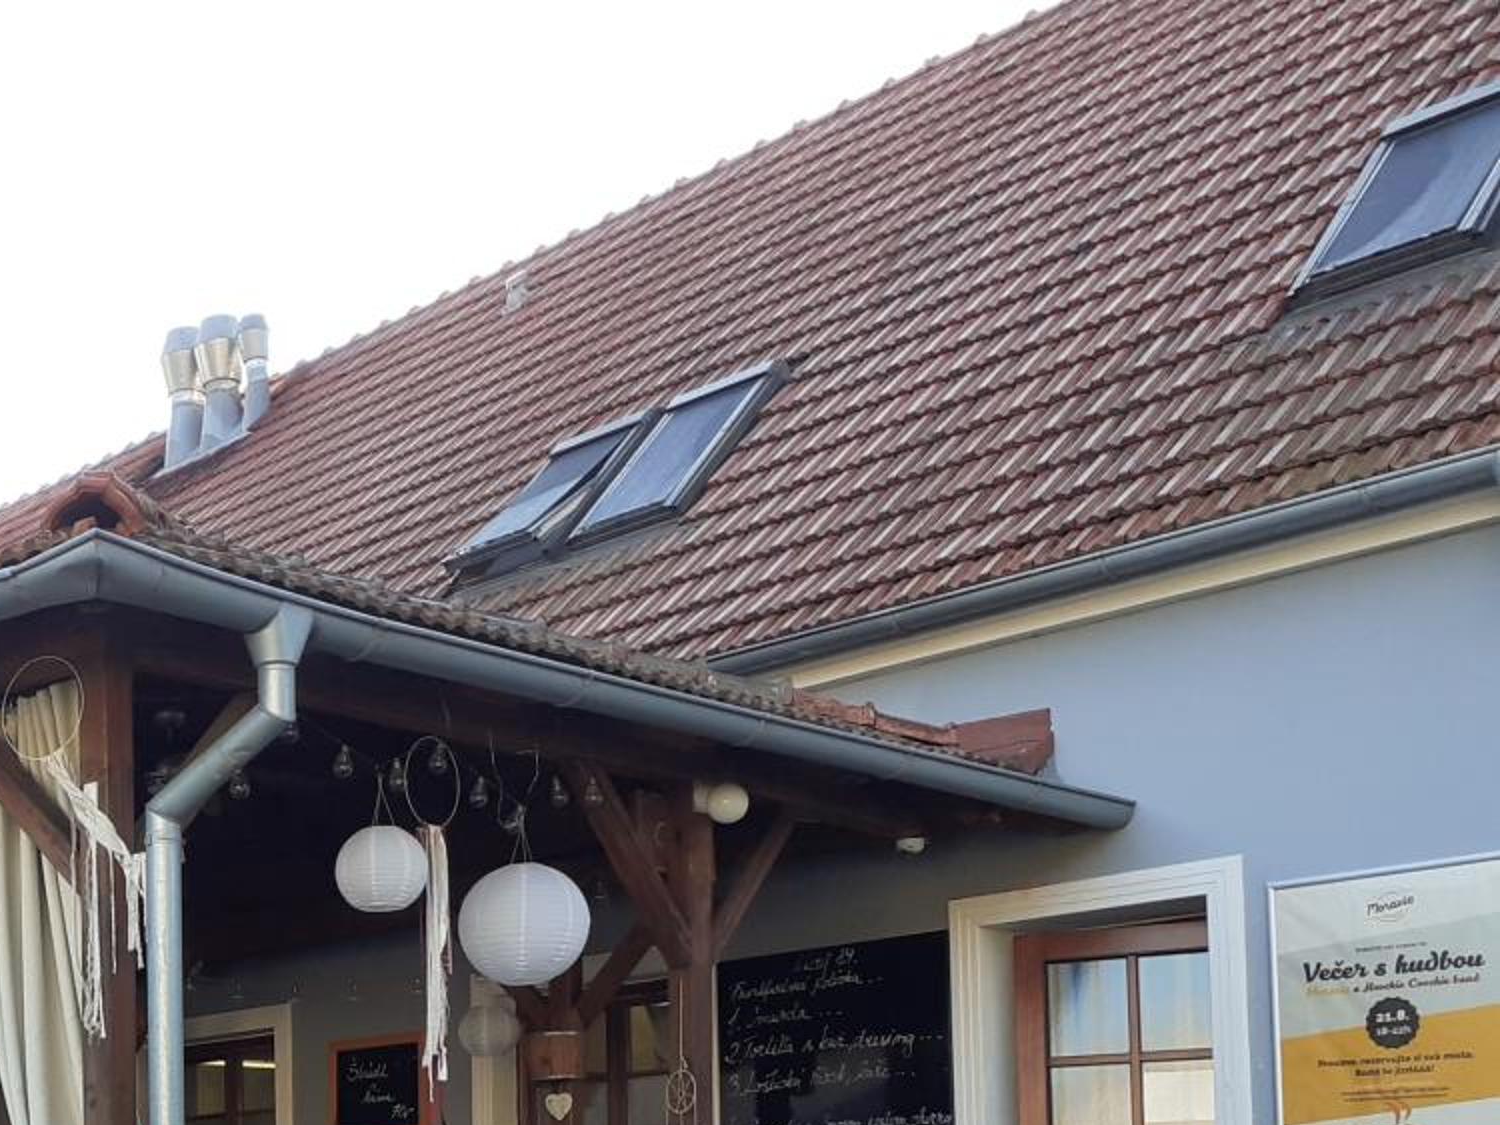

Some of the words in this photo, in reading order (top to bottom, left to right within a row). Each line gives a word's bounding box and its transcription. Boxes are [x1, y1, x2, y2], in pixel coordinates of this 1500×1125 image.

[1303, 960, 1369, 983] Večer
[1374, 962, 1387, 976] s
[1395, 949, 1485, 975] hudbou
